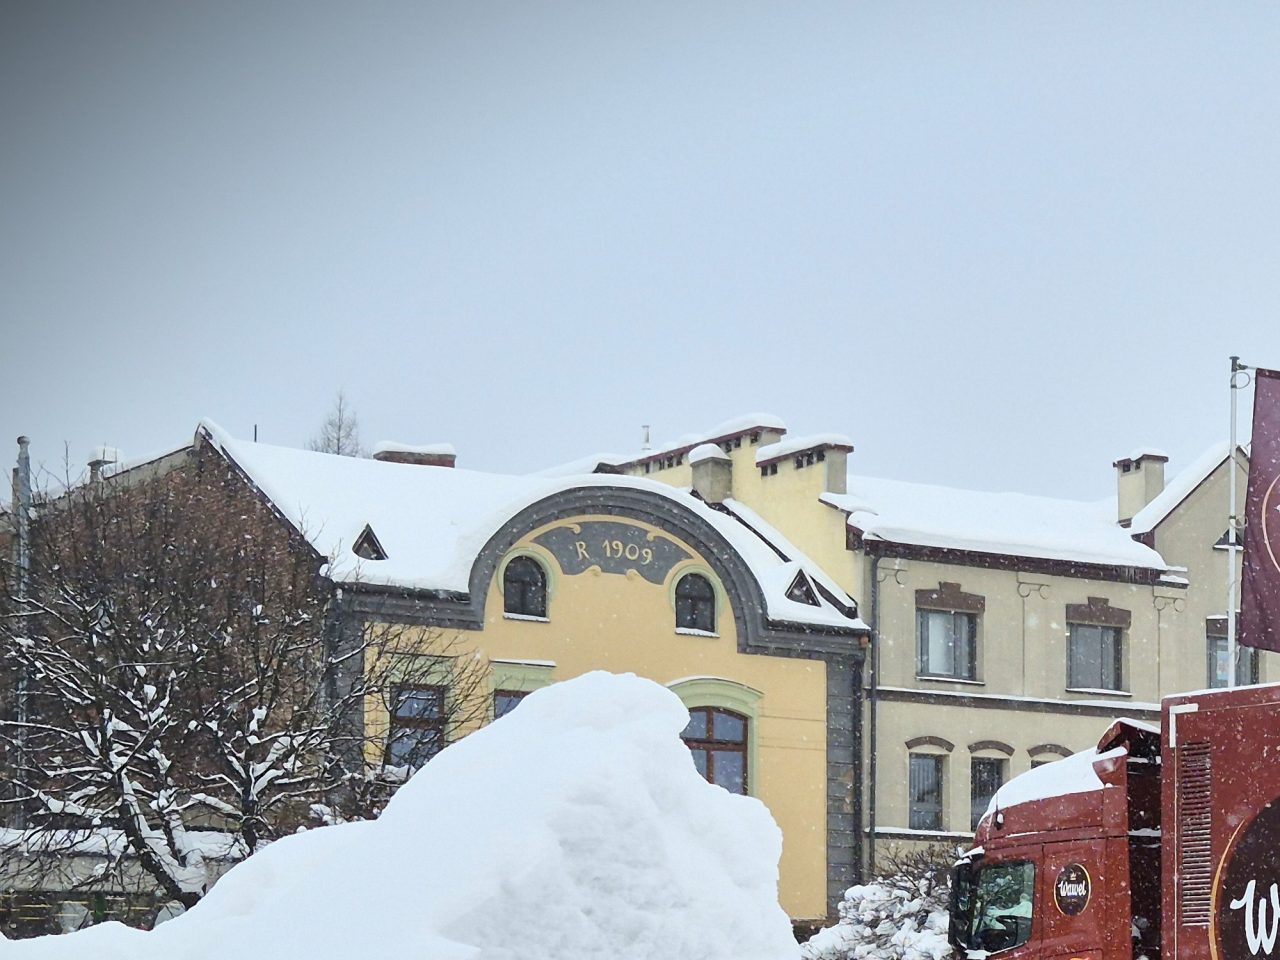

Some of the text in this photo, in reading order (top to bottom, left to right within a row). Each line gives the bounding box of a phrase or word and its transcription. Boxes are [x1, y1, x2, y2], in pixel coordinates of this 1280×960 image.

[575, 539, 653, 565] R 1909
[1058, 880, 1086, 896] Wawel
